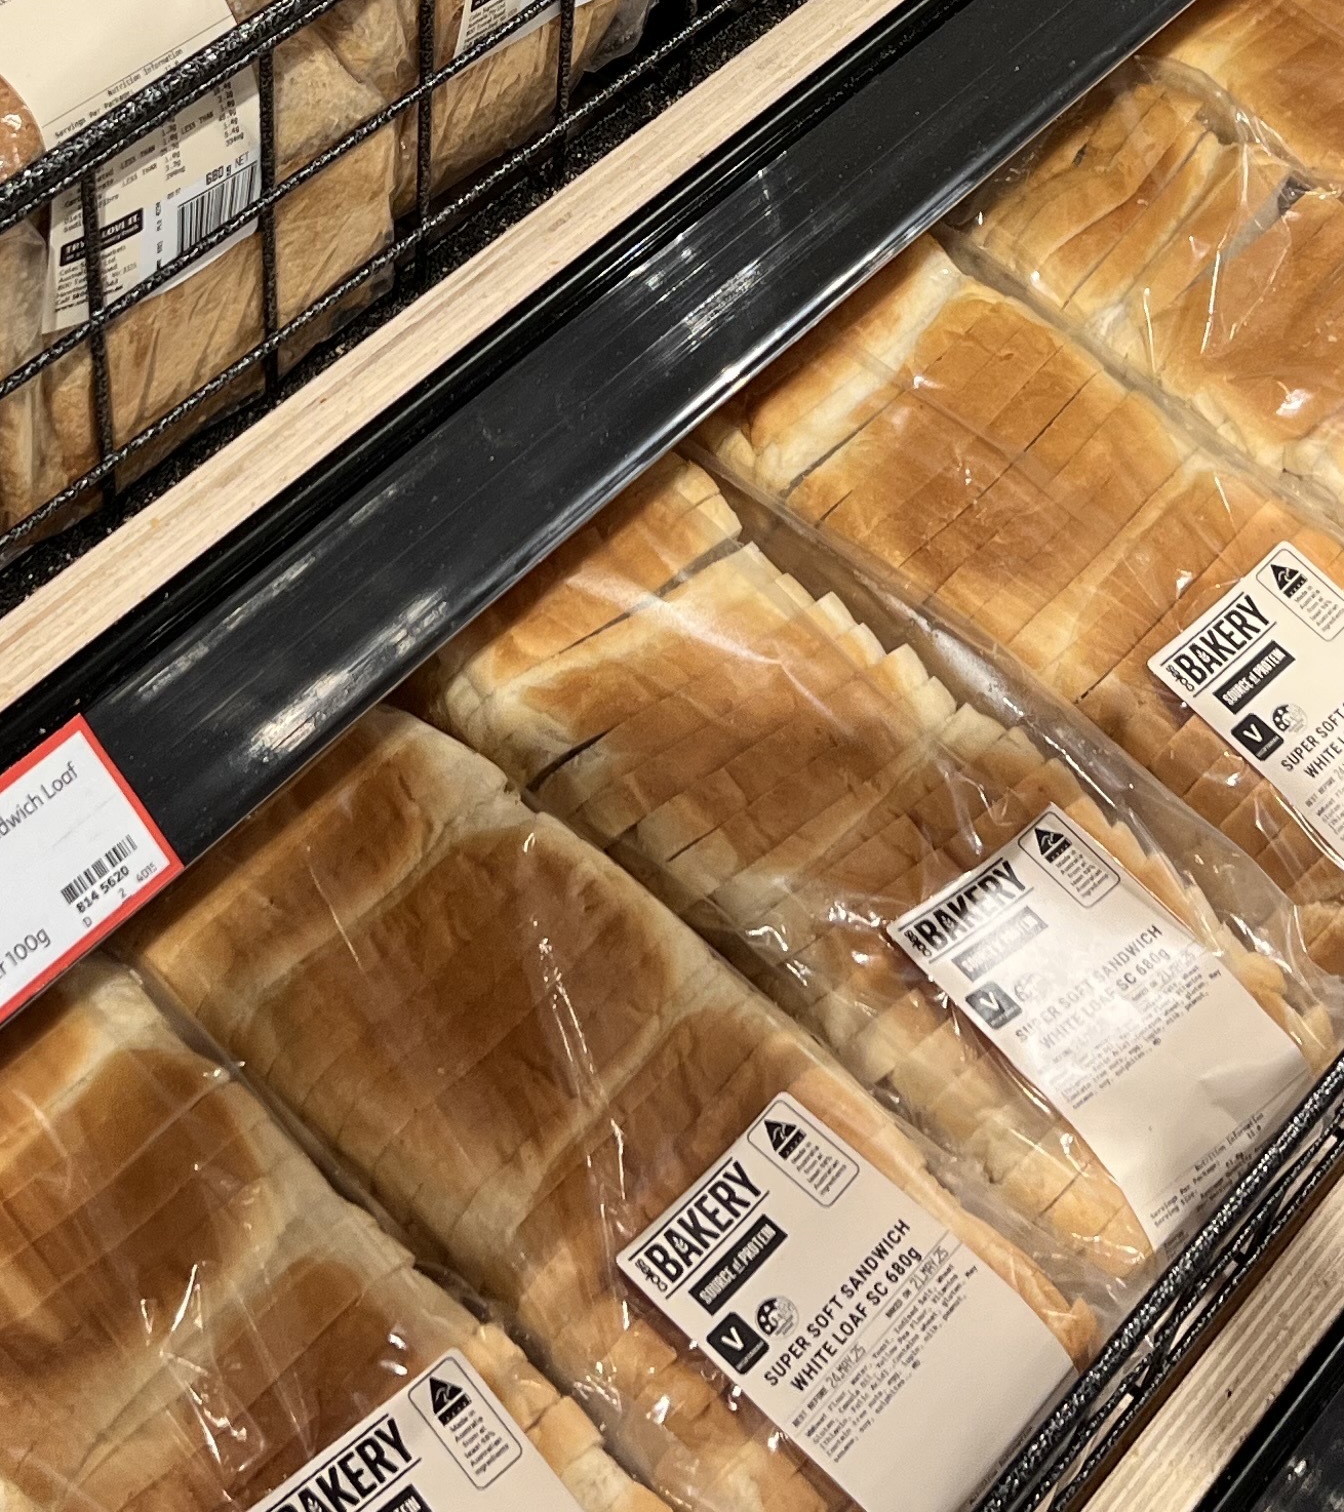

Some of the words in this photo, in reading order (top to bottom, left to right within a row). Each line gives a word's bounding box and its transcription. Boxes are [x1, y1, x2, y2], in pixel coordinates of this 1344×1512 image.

[1174, 594, 1270, 686] BAKERY
[1281, 731, 1321, 772] SUPER
[1316, 708, 1344, 740] SOFT
[1304, 738, 1343, 779] WHITE
[40, 760, 79, 800] Loaf
[76, 891, 99, 914] 814
[99, 866, 130, 896] 5620
[916, 860, 1025, 952] BAKERY
[4, 927, 52, 967] 100g
[1094, 925, 1163, 983] SANDWICH
[1135, 949, 1170, 978] 680g
[645, 1161, 762, 1283] BAKERY
[764, 1332, 811, 1386] SUPER
[808, 1293, 845, 1339] SOFT
[841, 1219, 911, 1300] SANDWICH
[791, 1338, 838, 1393] WHITE
[835, 1302, 871, 1348] LOAF
[867, 1283, 890, 1310] SC
[885, 1247, 923, 1289] 680g
